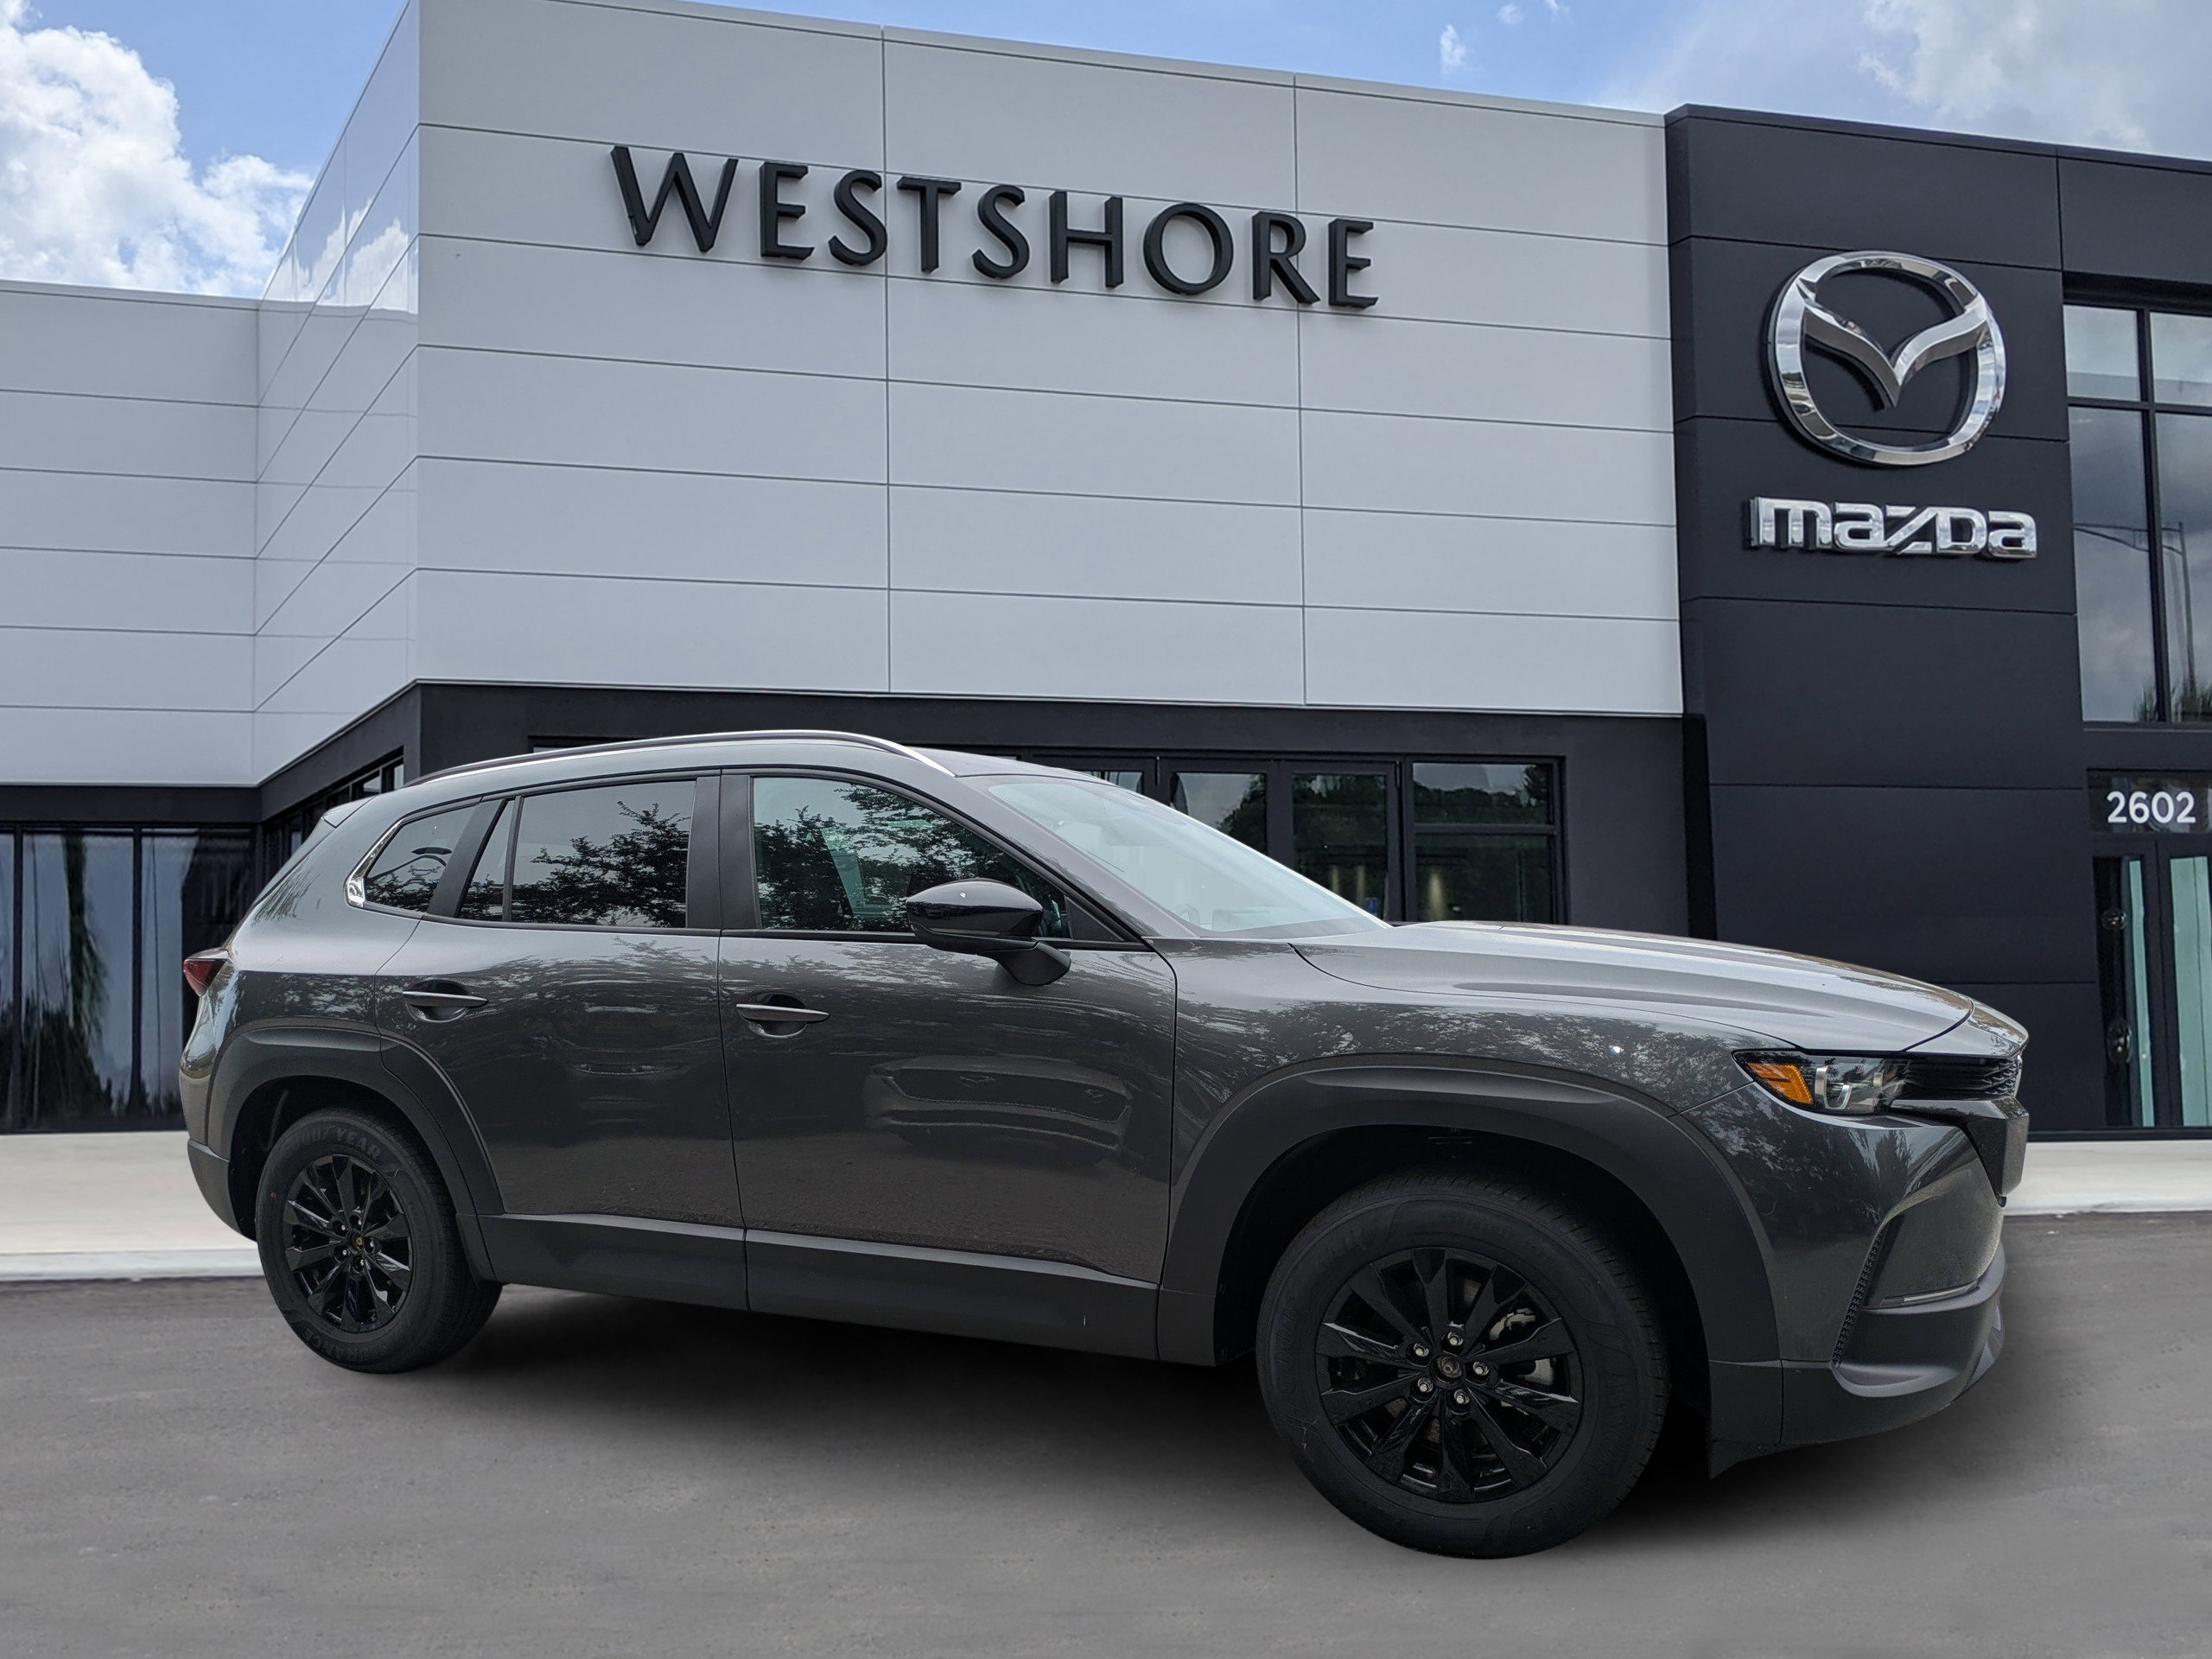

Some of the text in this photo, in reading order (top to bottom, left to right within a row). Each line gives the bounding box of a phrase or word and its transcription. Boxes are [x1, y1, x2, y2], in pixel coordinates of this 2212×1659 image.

[610, 144, 1378, 312] WESTSHORE
[1751, 496, 2037, 559] mazda
[2107, 791, 2196, 823] 2602
